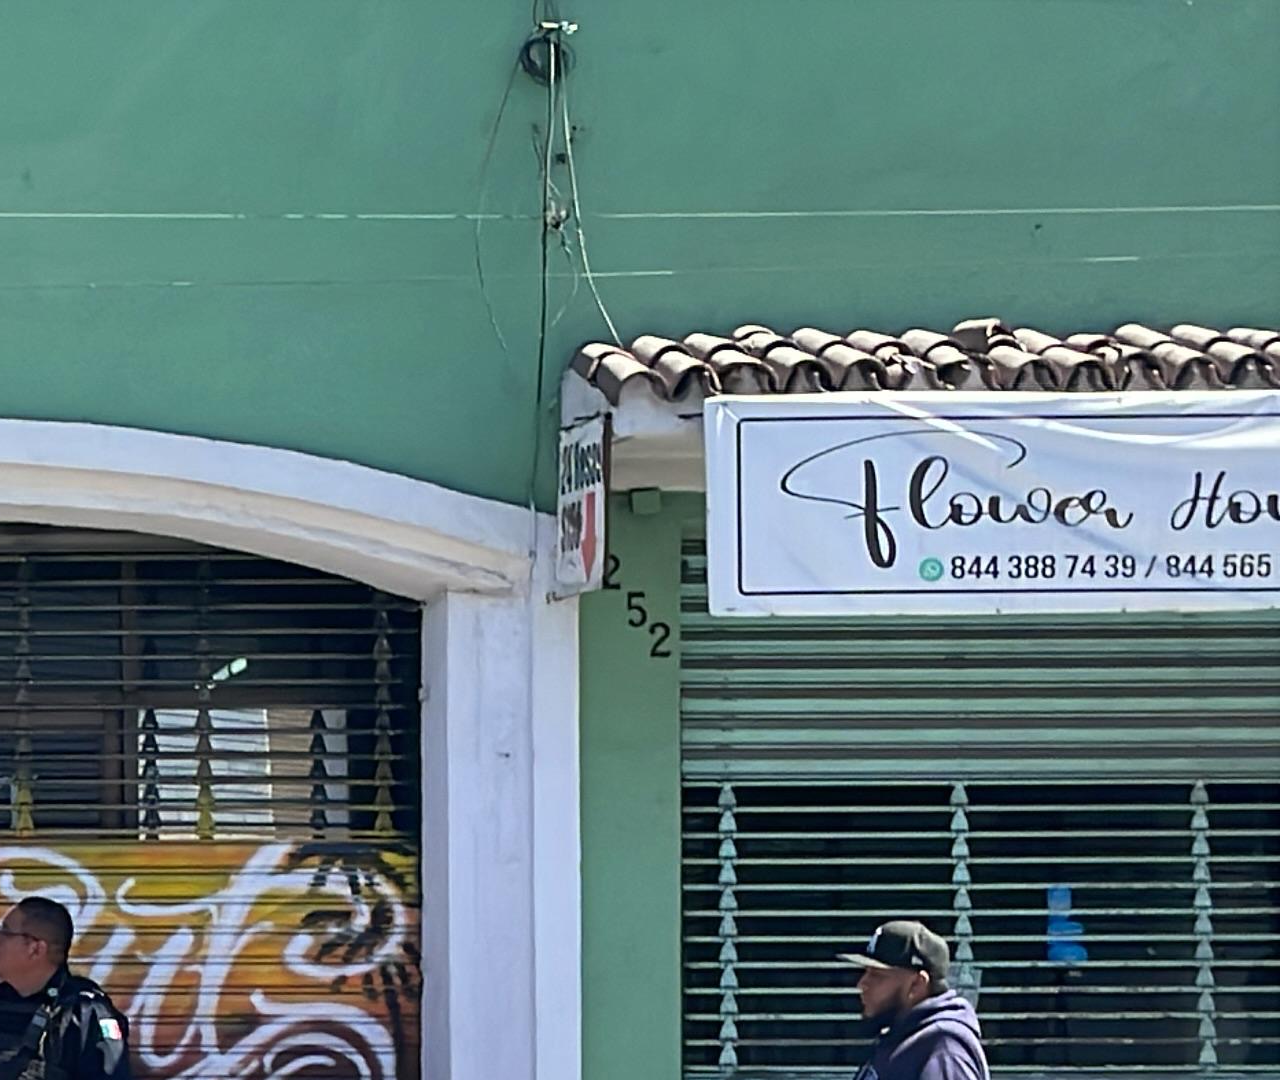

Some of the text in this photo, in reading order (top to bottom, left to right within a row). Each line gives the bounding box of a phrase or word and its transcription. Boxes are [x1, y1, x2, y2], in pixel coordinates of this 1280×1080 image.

[950, 555, 999, 579] 844
[1007, 555, 1056, 579] 388
[1064, 555, 1096, 579] 74
[1104, 555, 1136, 579] 39
[1166, 555, 1214, 578] 844
[1223, 554, 1271, 578] 565
[603, 554, 671, 657] 252
